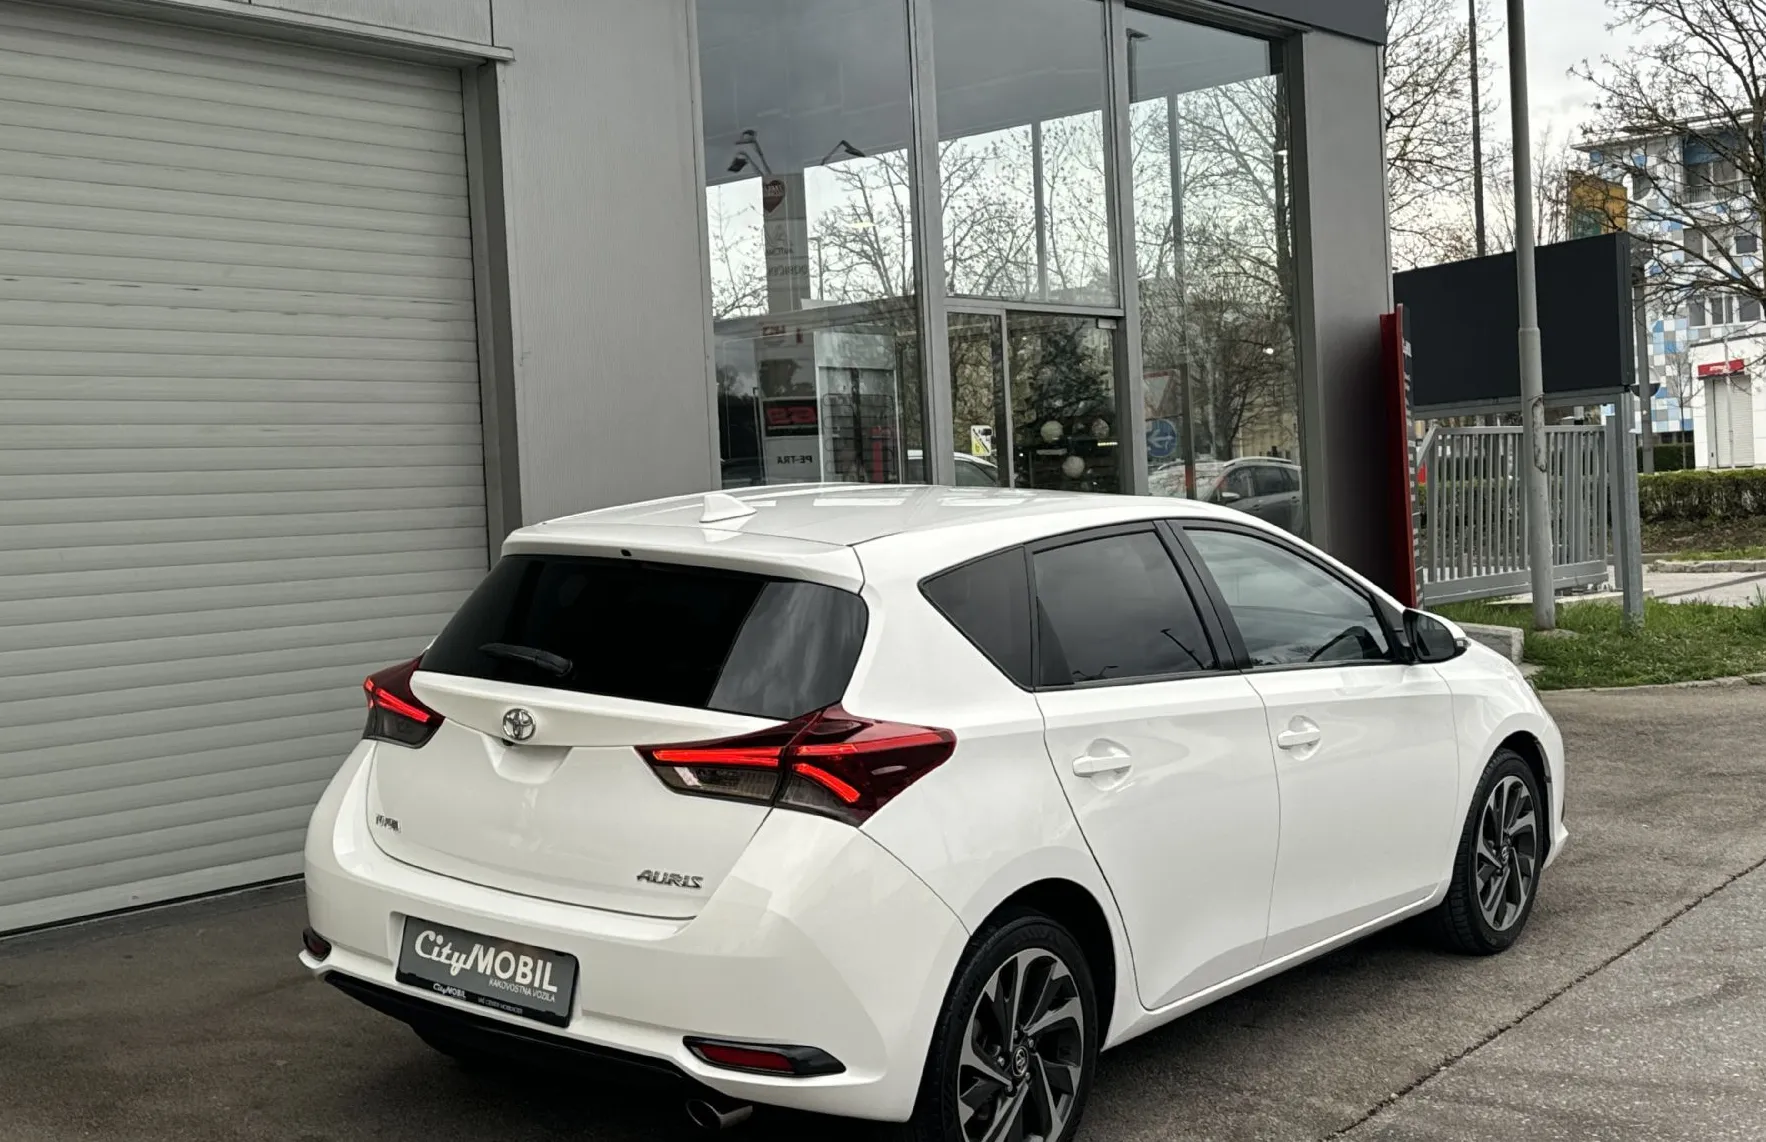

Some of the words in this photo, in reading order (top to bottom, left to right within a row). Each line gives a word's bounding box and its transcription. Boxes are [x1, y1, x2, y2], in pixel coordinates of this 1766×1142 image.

[637, 869, 704, 889] AURIS
[488, 978, 532, 996] KAKOVOSTNA
[532, 989, 556, 1002] VOZILA
